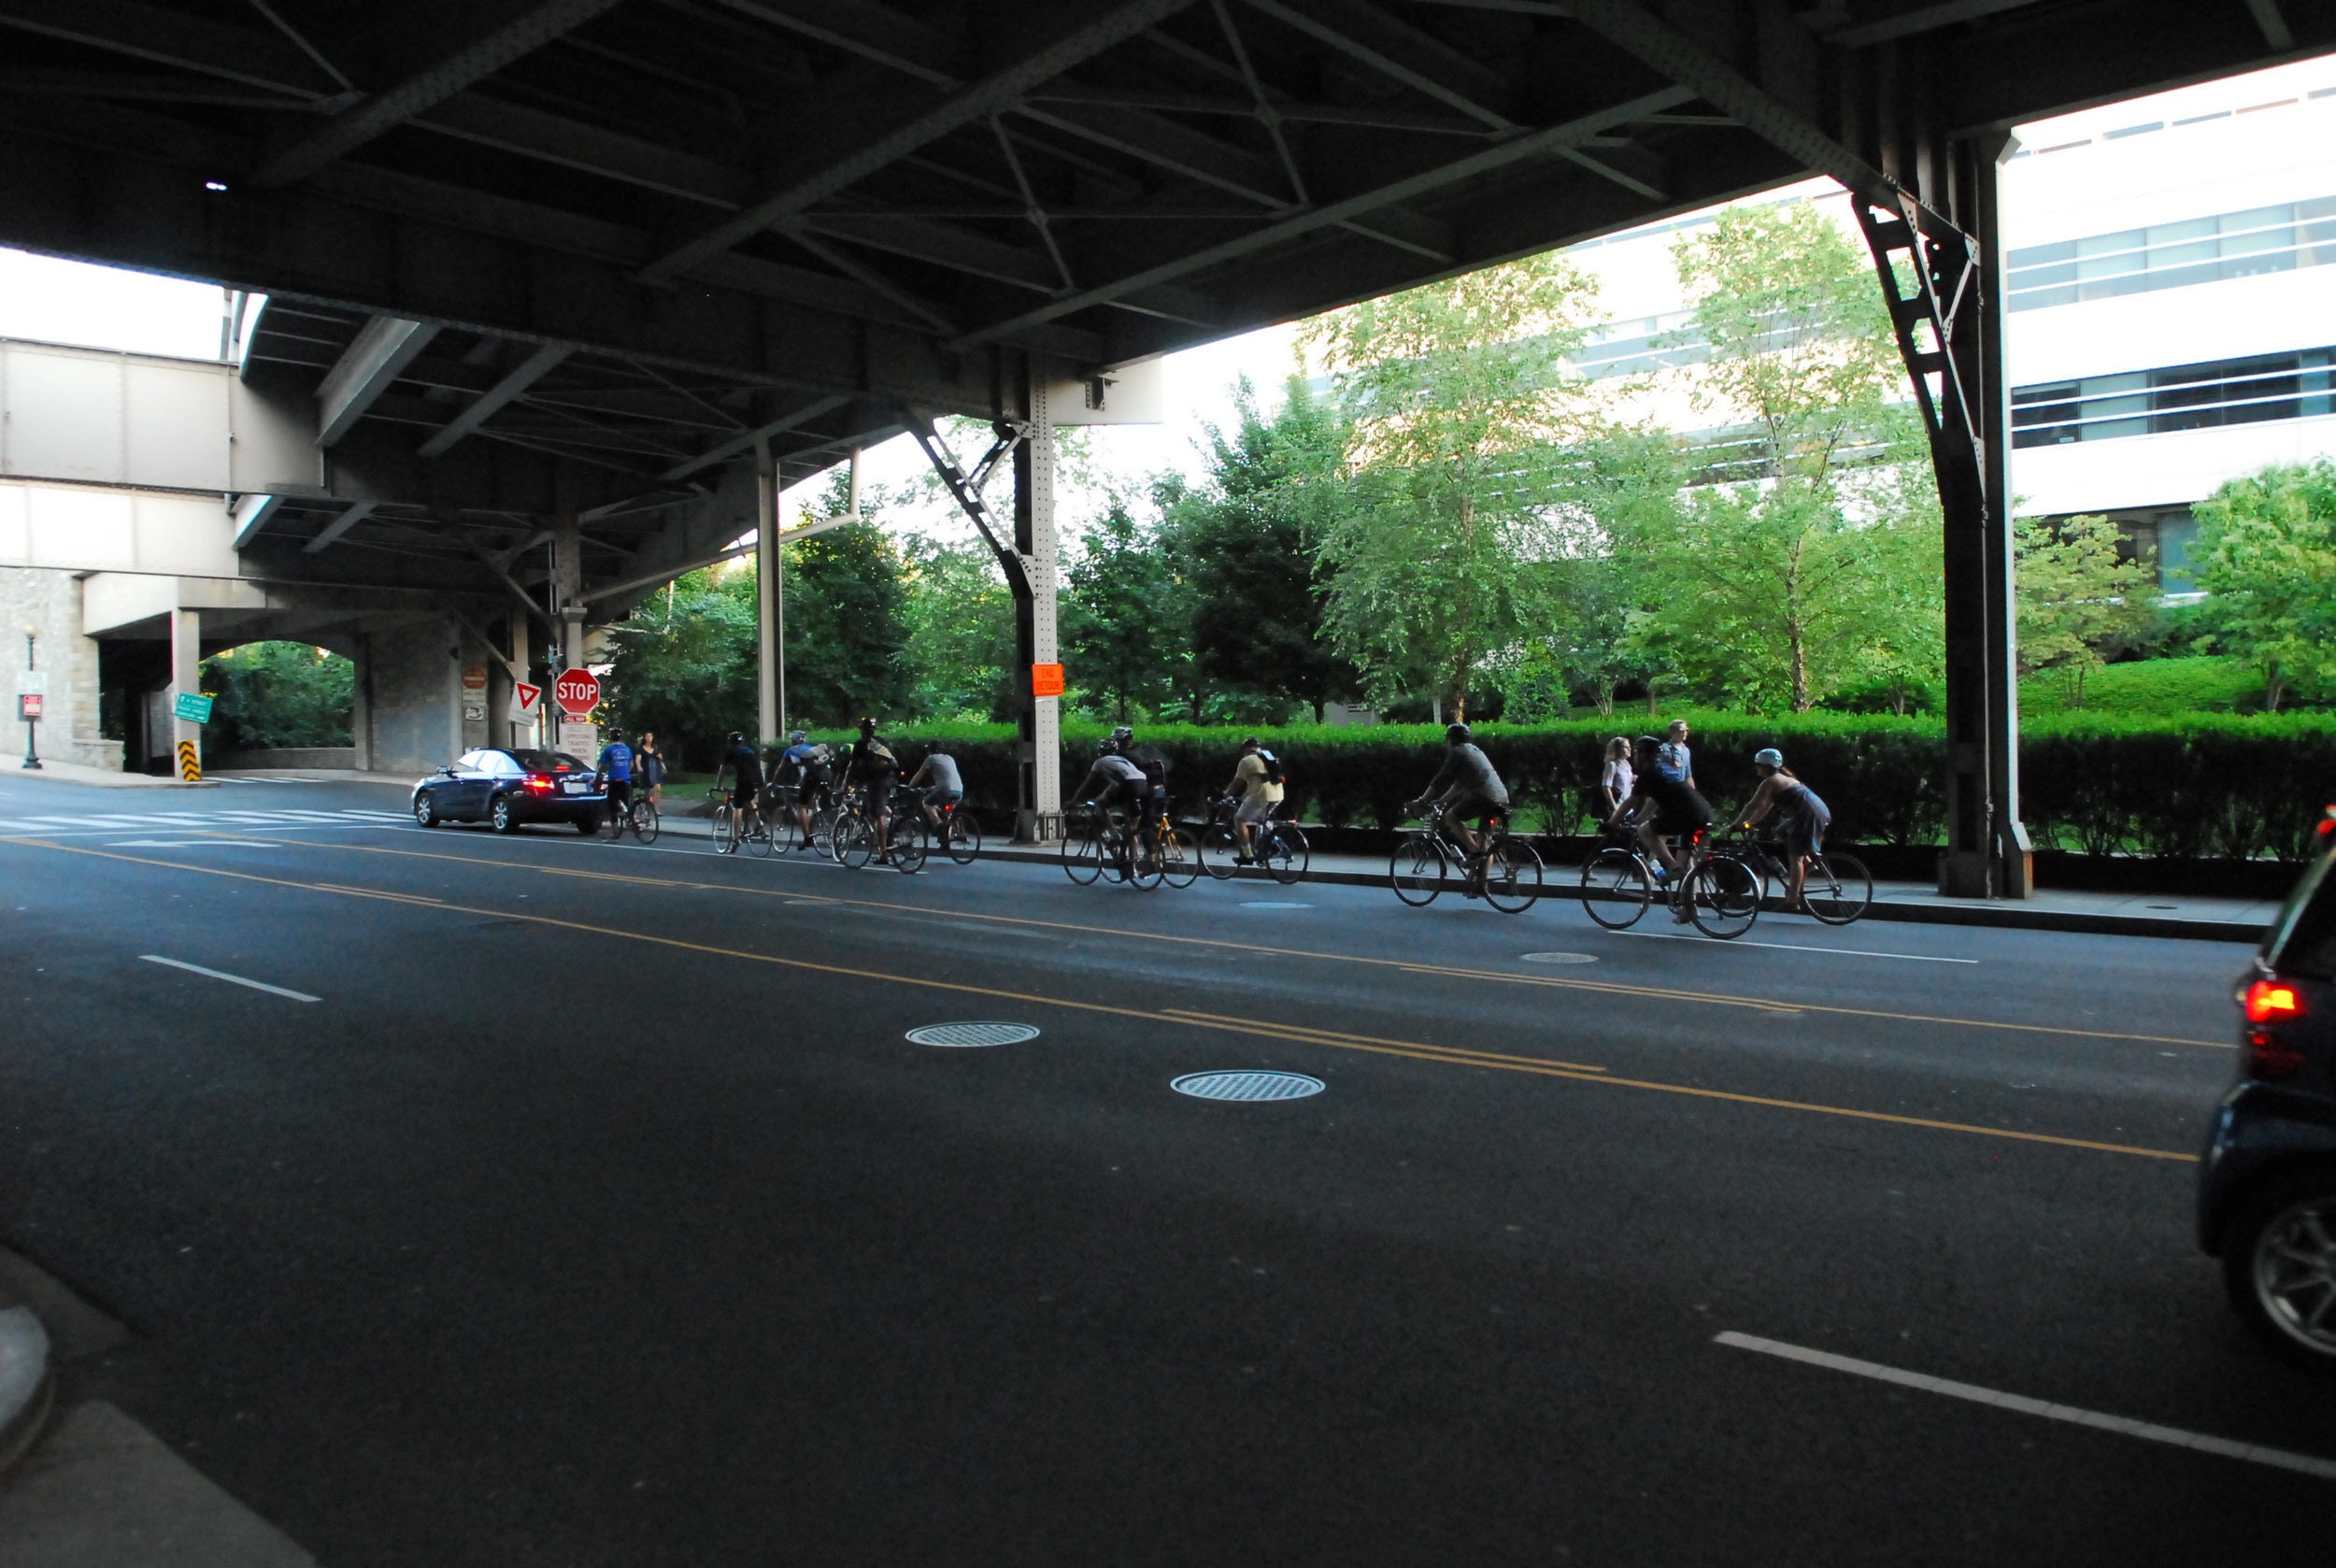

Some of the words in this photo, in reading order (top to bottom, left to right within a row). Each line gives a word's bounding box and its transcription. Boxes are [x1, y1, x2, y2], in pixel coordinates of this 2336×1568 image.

[1041, 668, 1054, 678] END
[558, 681, 597, 701] STOP
[1036, 680, 1060, 691] DETOUR
